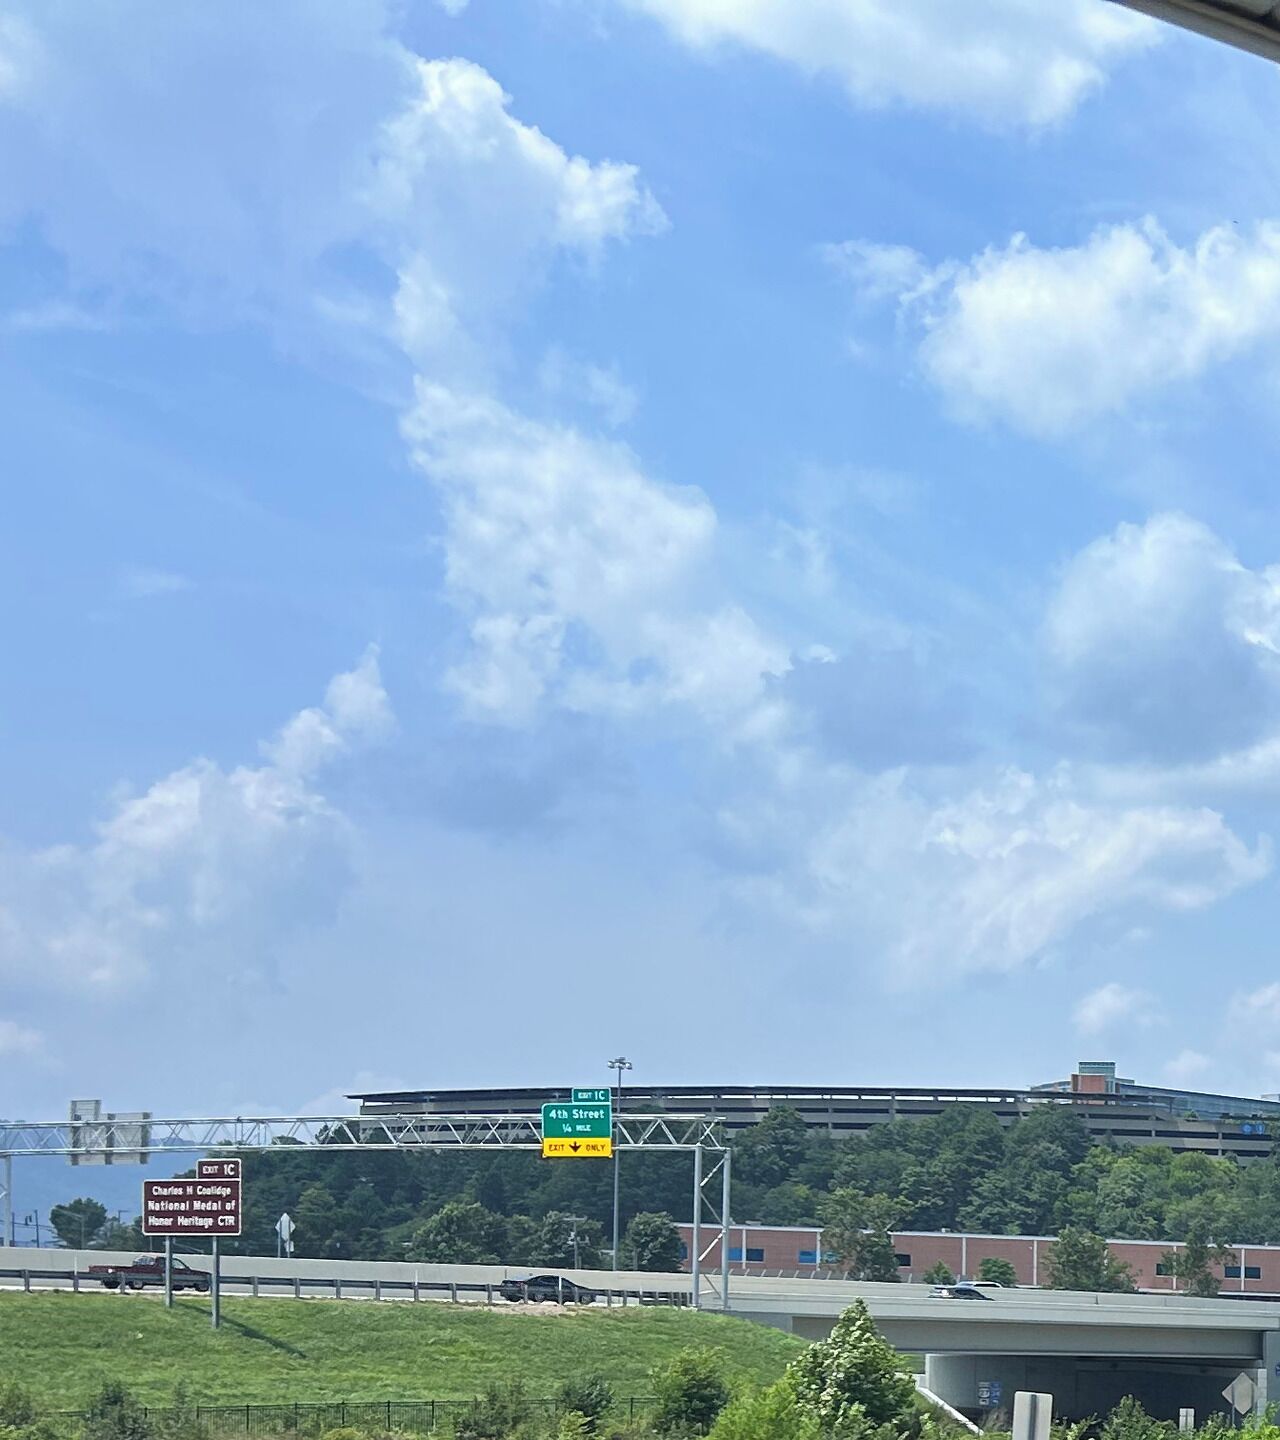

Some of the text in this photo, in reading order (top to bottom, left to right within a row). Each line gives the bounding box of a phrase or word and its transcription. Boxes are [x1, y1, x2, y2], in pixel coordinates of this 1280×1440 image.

[549, 1109, 605, 1119] 4th Street
[576, 1124, 592, 1132] MILE
[548, 1144, 606, 1152] EXIT ONLY
[202, 1165, 219, 1174] EXIT
[152, 1186, 183, 1196] Charles
[196, 1186, 232, 1198] Coolidge
[147, 1200, 236, 1211] National Medal of
[148, 1215, 235, 1229] Honor Heritage CTR
